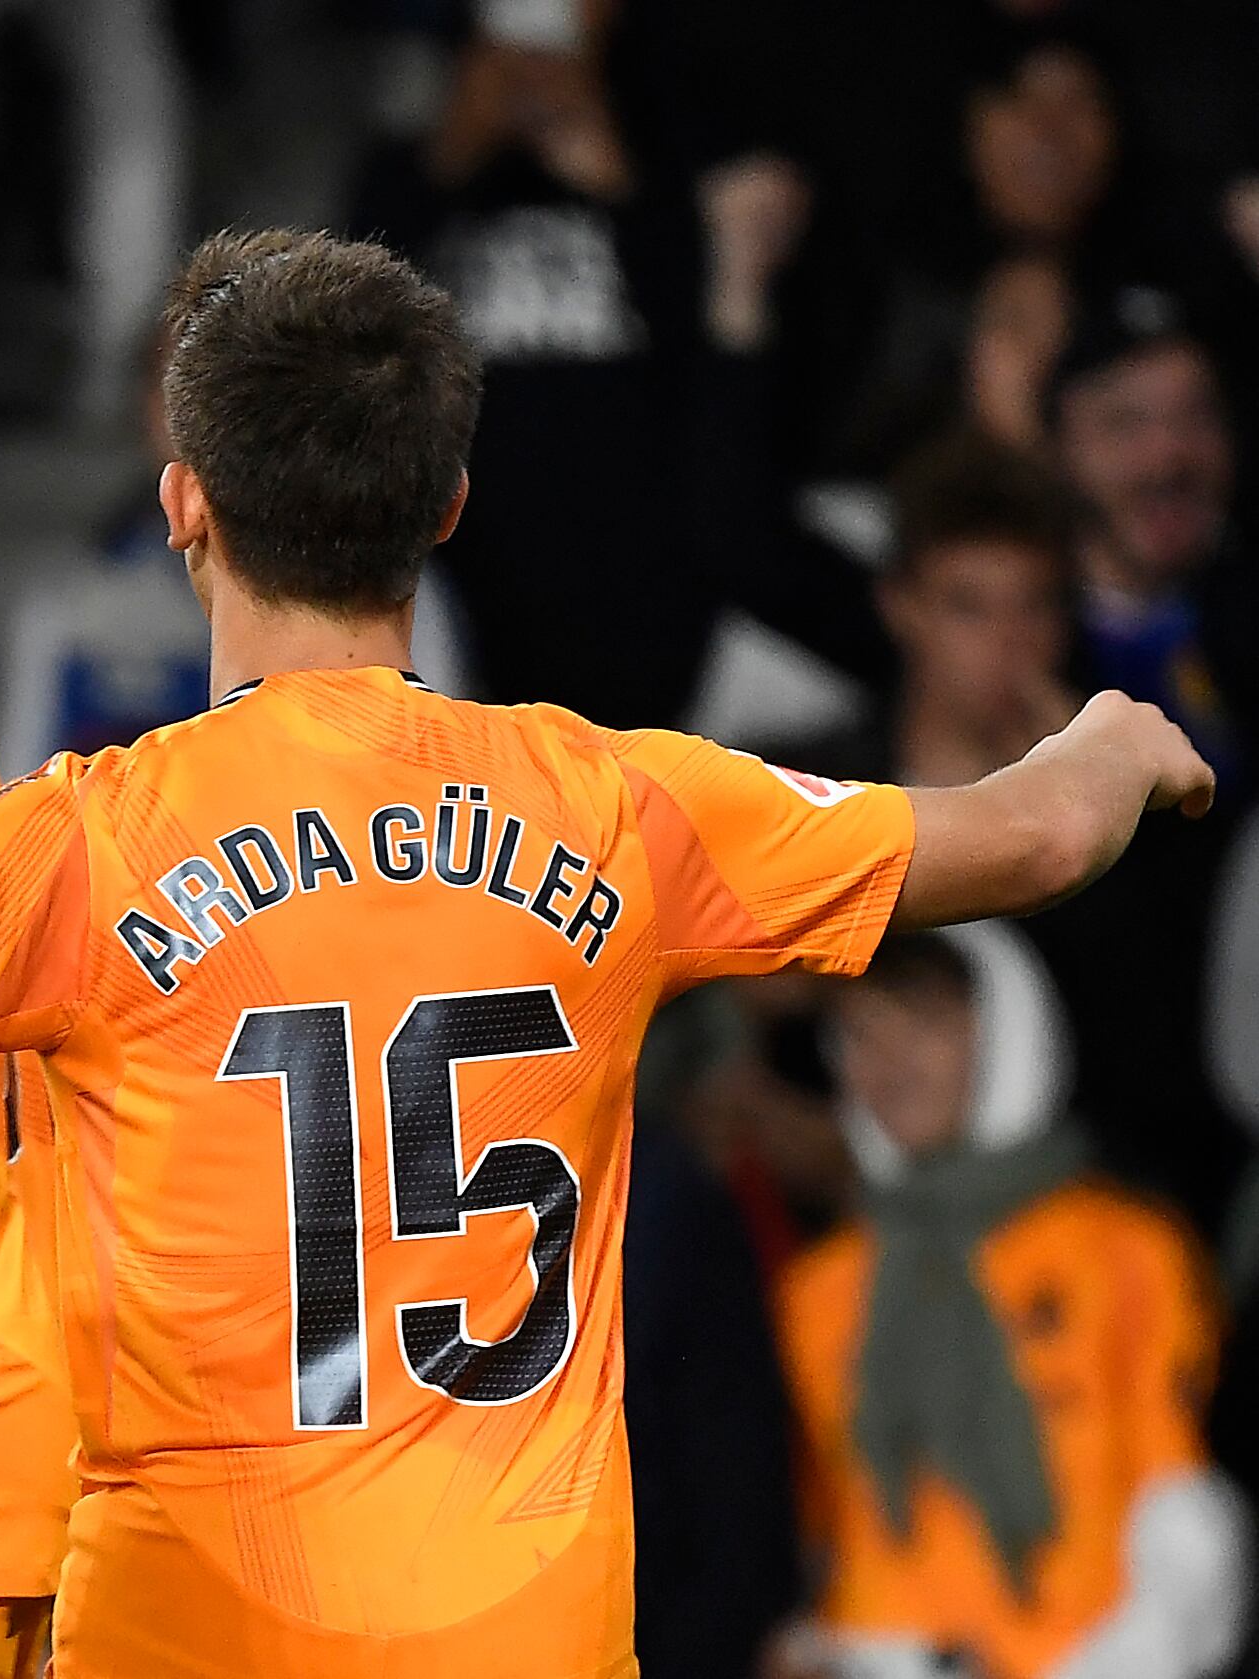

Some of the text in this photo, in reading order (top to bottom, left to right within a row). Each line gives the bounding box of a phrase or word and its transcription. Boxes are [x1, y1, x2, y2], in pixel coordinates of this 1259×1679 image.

[115, 783, 622, 995] ARDA GÜLER
[215, 984, 580, 1430] 15
